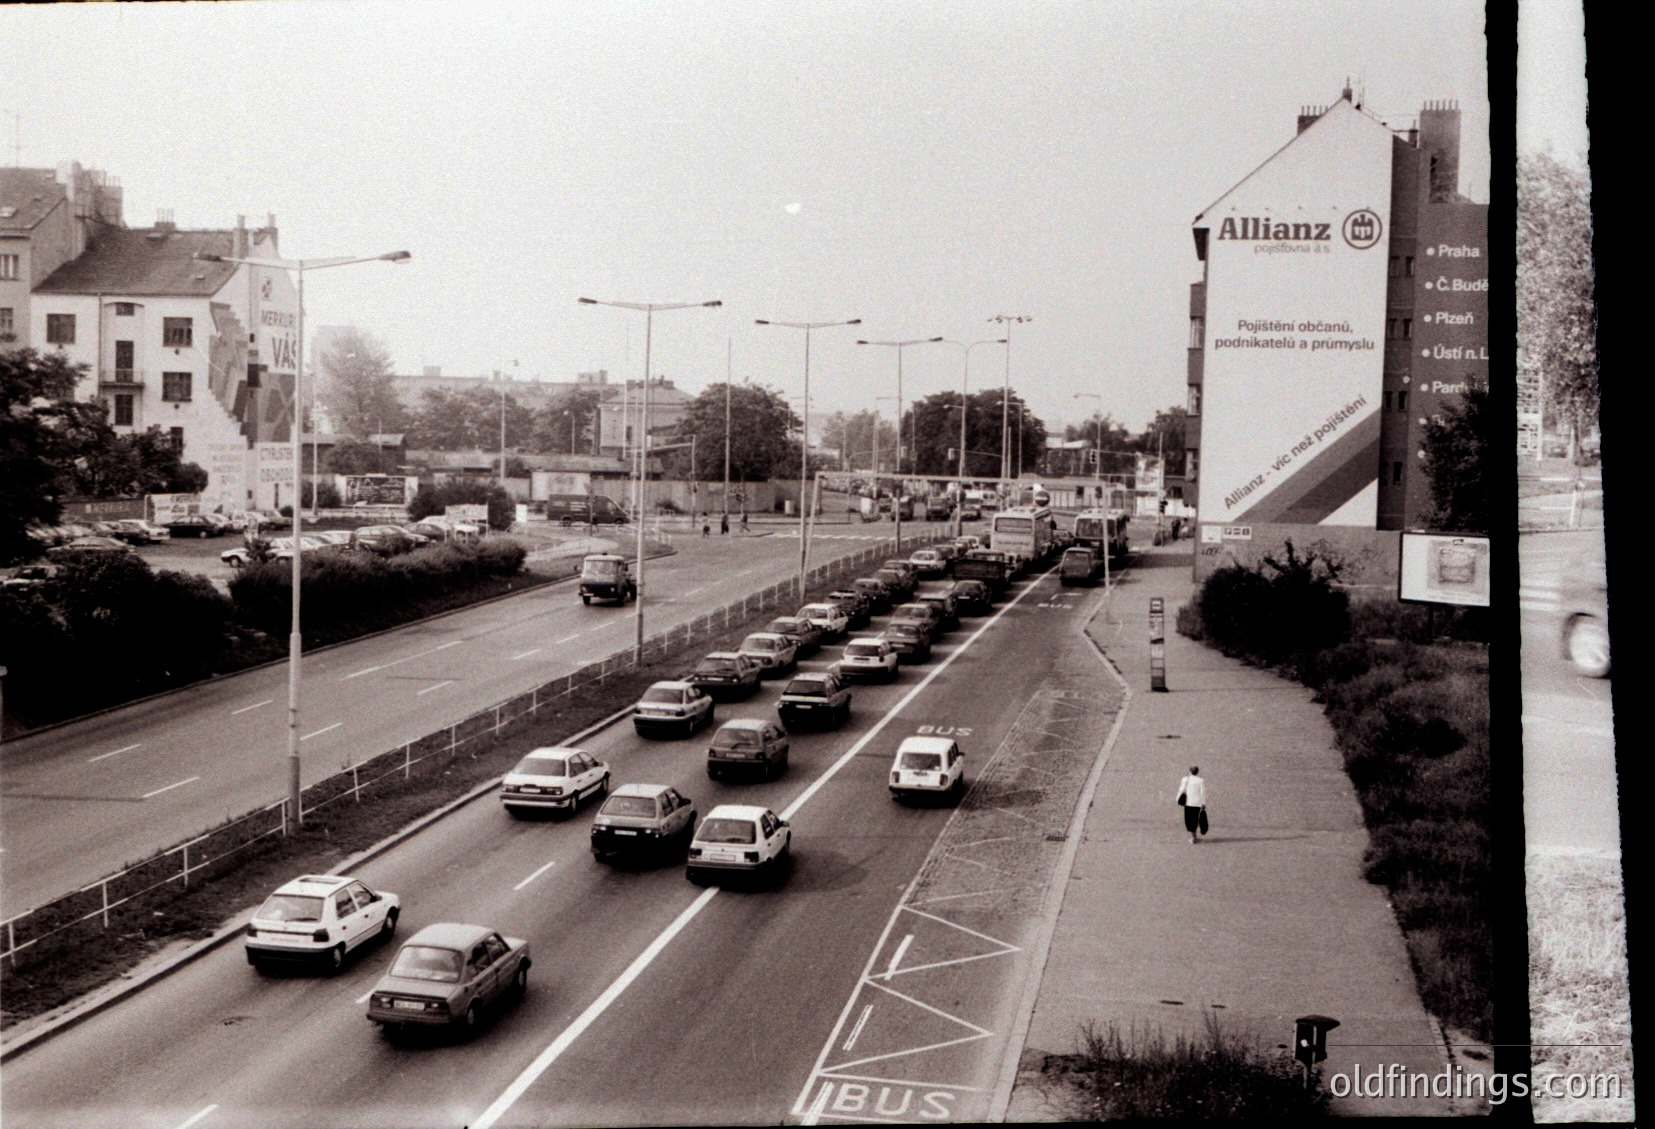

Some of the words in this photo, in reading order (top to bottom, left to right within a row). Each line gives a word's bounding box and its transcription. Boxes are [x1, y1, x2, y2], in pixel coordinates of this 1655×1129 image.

[1217, 216, 1332, 241] Allianz
[1438, 244, 1480, 258] Praha
[1436, 275, 1451, 291] Č.
[1435, 311, 1474, 325] Plzeň
[1237, 319, 1295, 334] Pojištění
[1298, 319, 1354, 334] občanů,
[1214, 335, 1296, 350] podnikatelů
[1299, 339, 1308, 349] a
[1311, 337, 1375, 352] průmyslu
[1433, 343, 1463, 359] Ústí
[1224, 474, 1266, 509] Allianz
[1291, 434, 1315, 457] než
[1314, 394, 1368, 441] pojištění
[916, 725, 974, 736] BUS
[831, 1083, 956, 1120] BUS
